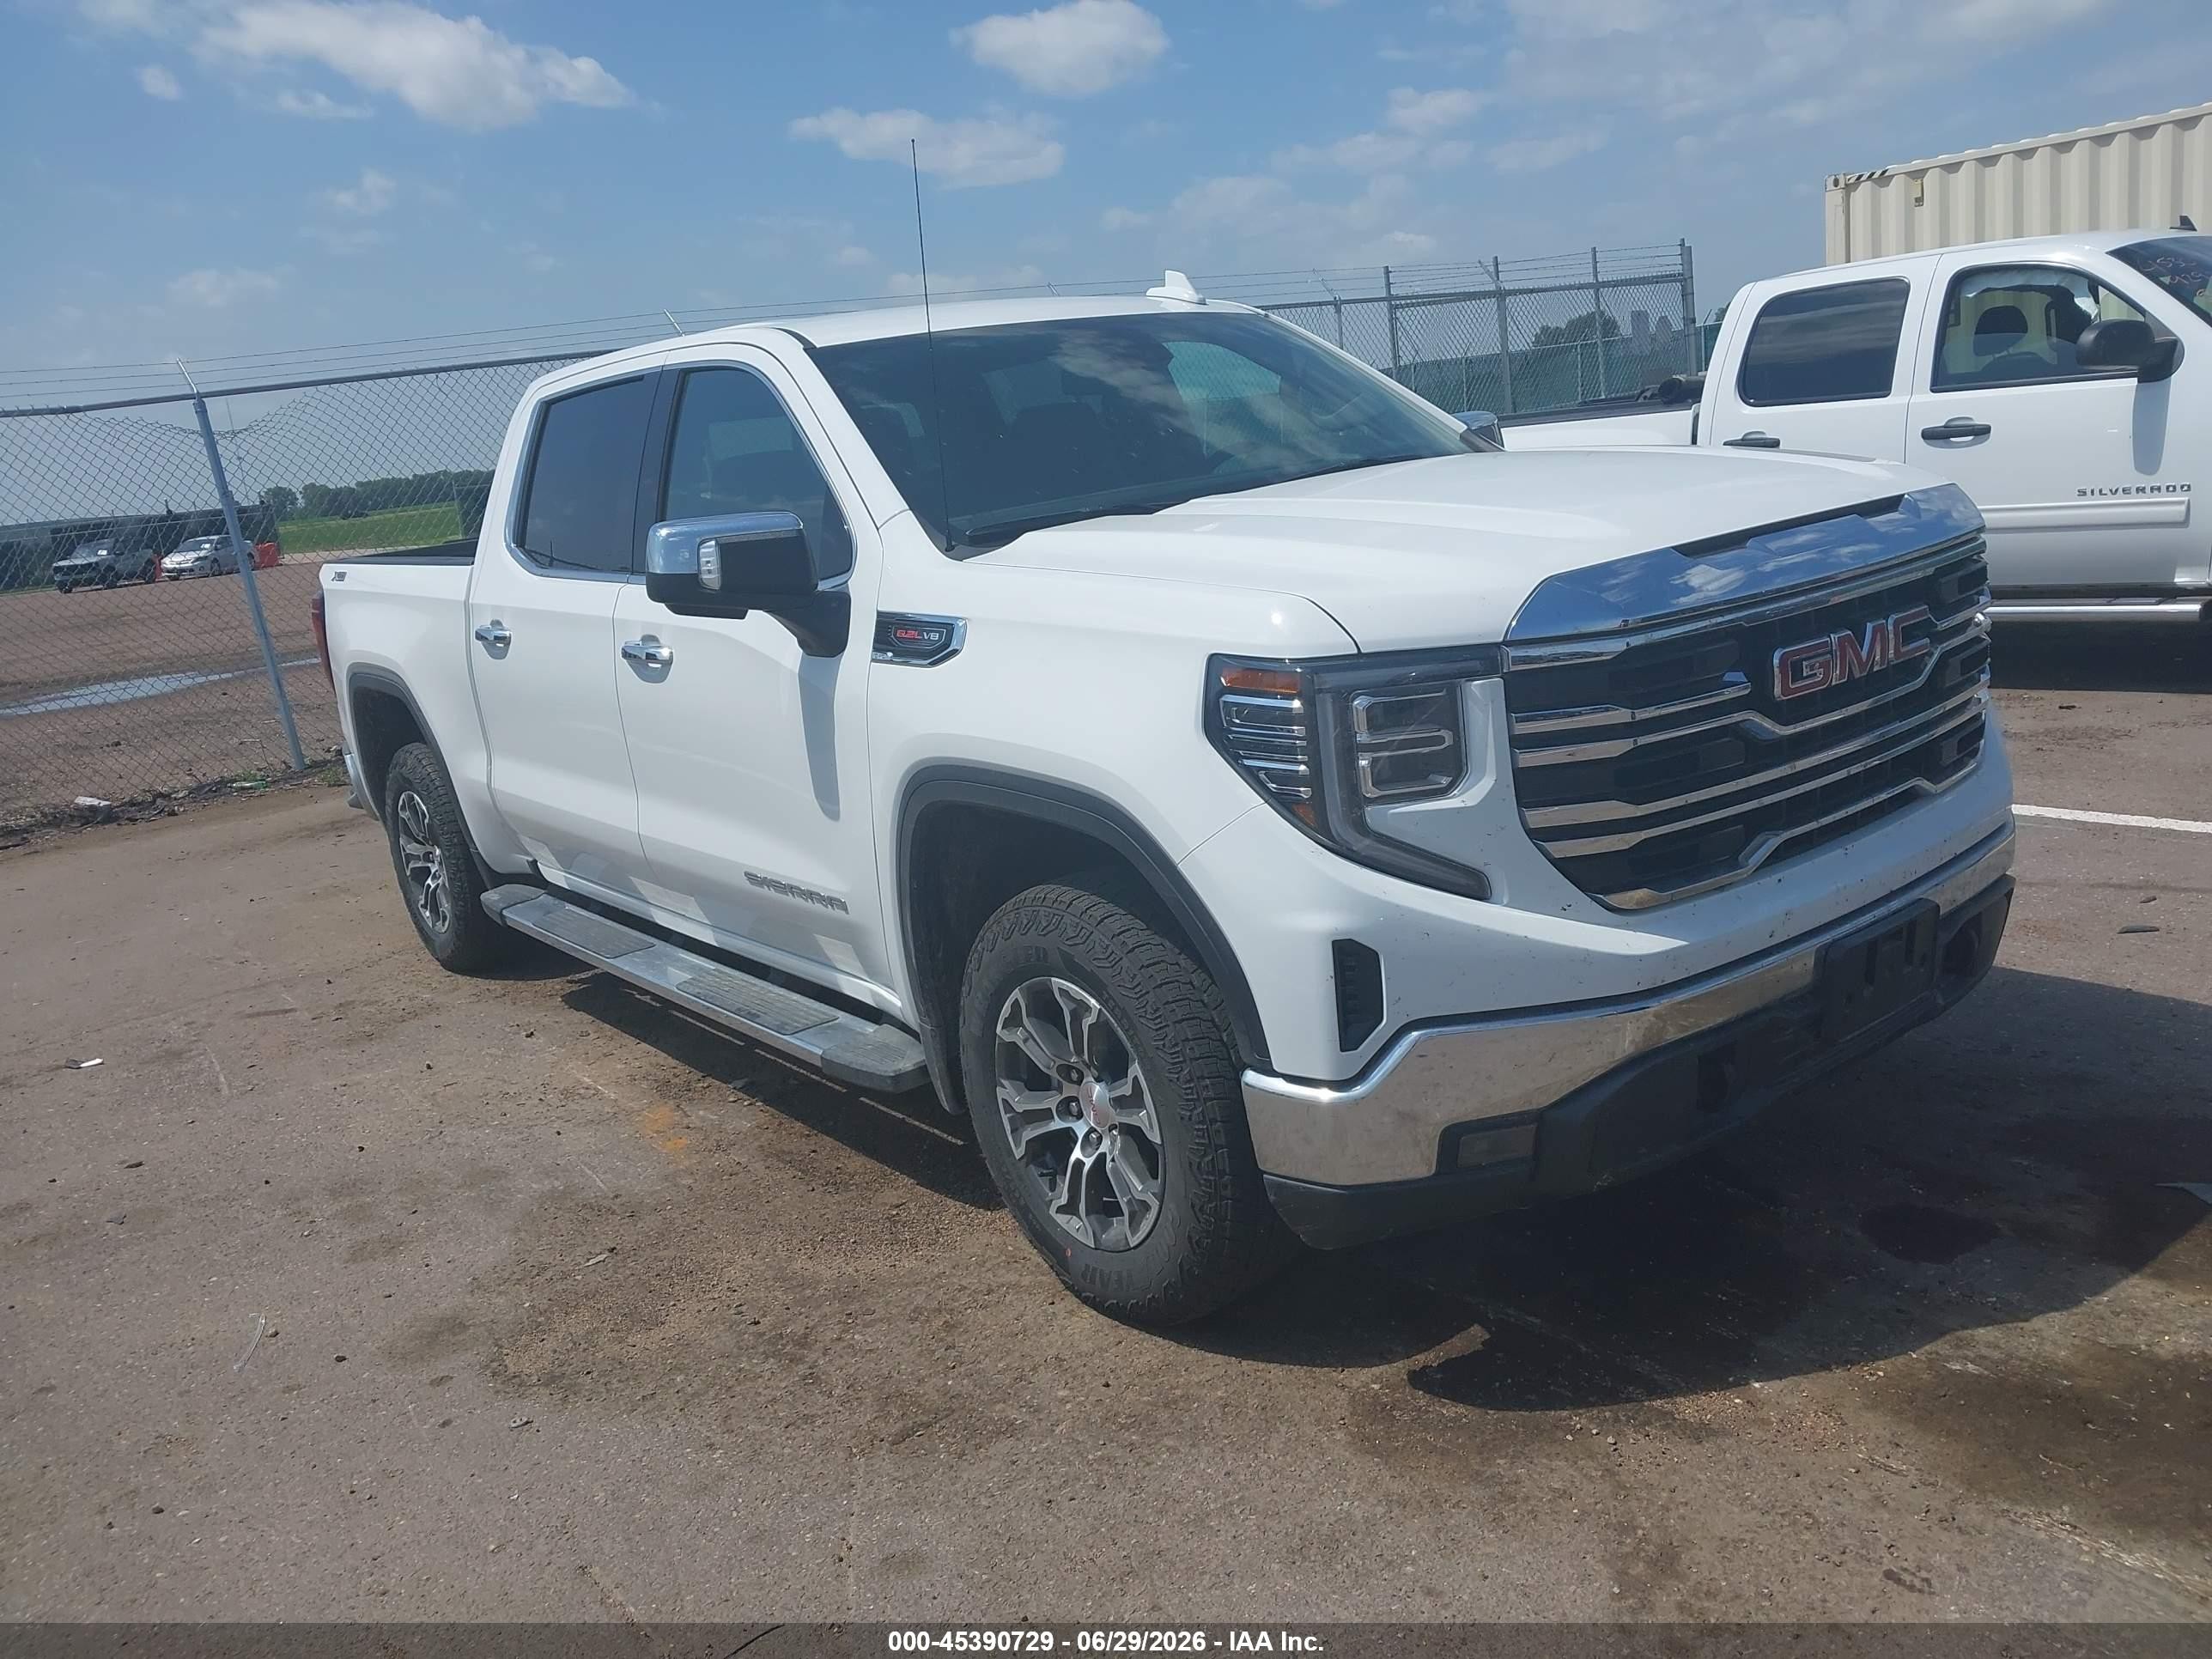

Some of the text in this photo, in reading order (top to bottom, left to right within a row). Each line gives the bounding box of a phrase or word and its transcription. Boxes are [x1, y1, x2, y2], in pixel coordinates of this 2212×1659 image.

[2076, 482, 2191, 496] SILVERADO
[923, 632, 939, 641] V8
[1773, 605, 1930, 701] GMC
[744, 871, 849, 915] SIERRA
